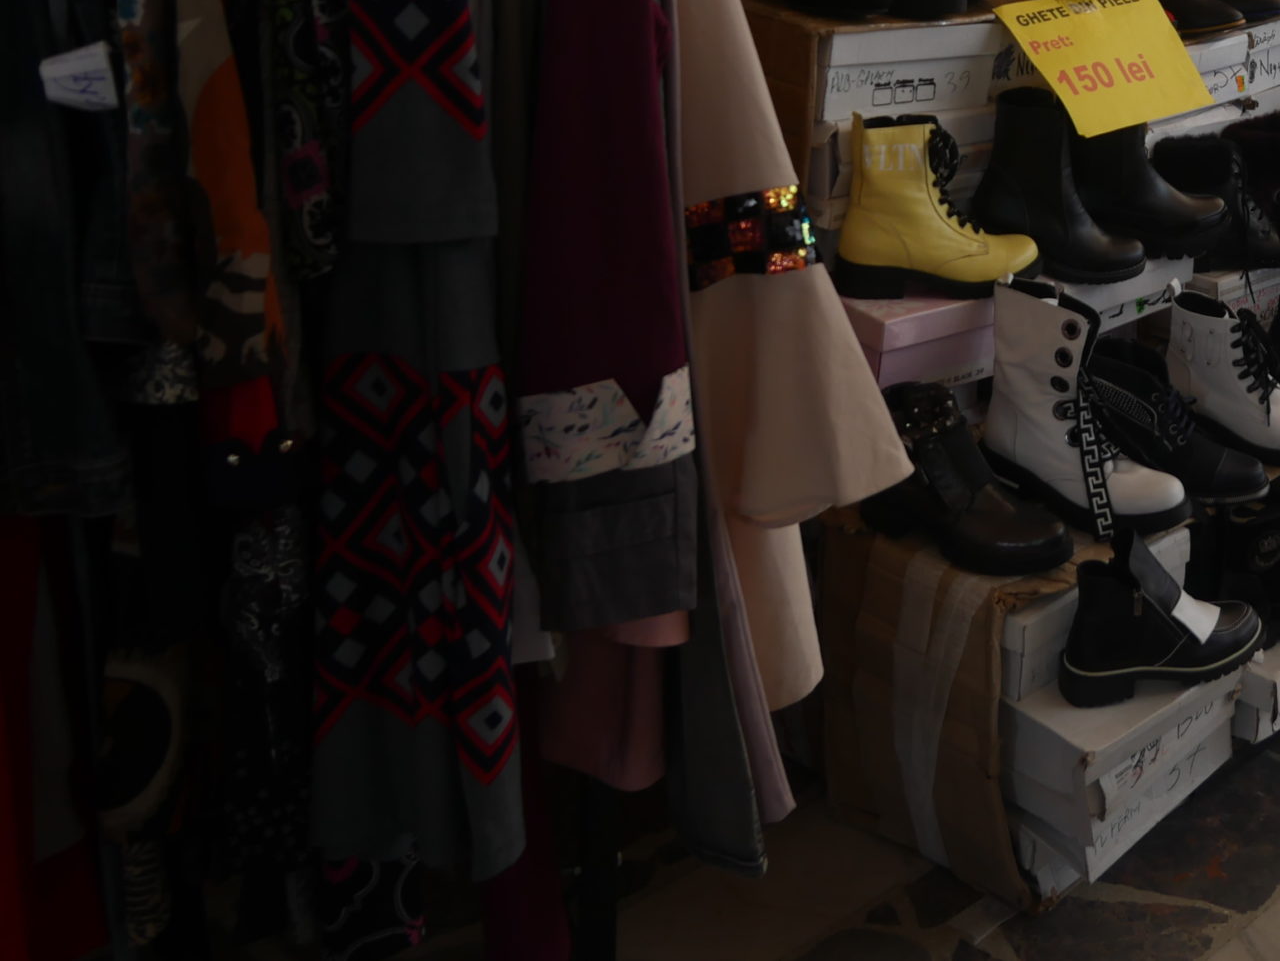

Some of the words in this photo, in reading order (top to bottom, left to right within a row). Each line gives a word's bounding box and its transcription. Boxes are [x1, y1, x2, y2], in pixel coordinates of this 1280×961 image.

[1016, 5, 1070, 27] GHETE
[1068, 0, 1098, 15] DIN
[1029, 35, 1074, 55] Pret:
[1056, 61, 1115, 96] 150
[1114, 54, 1156, 84] lei
